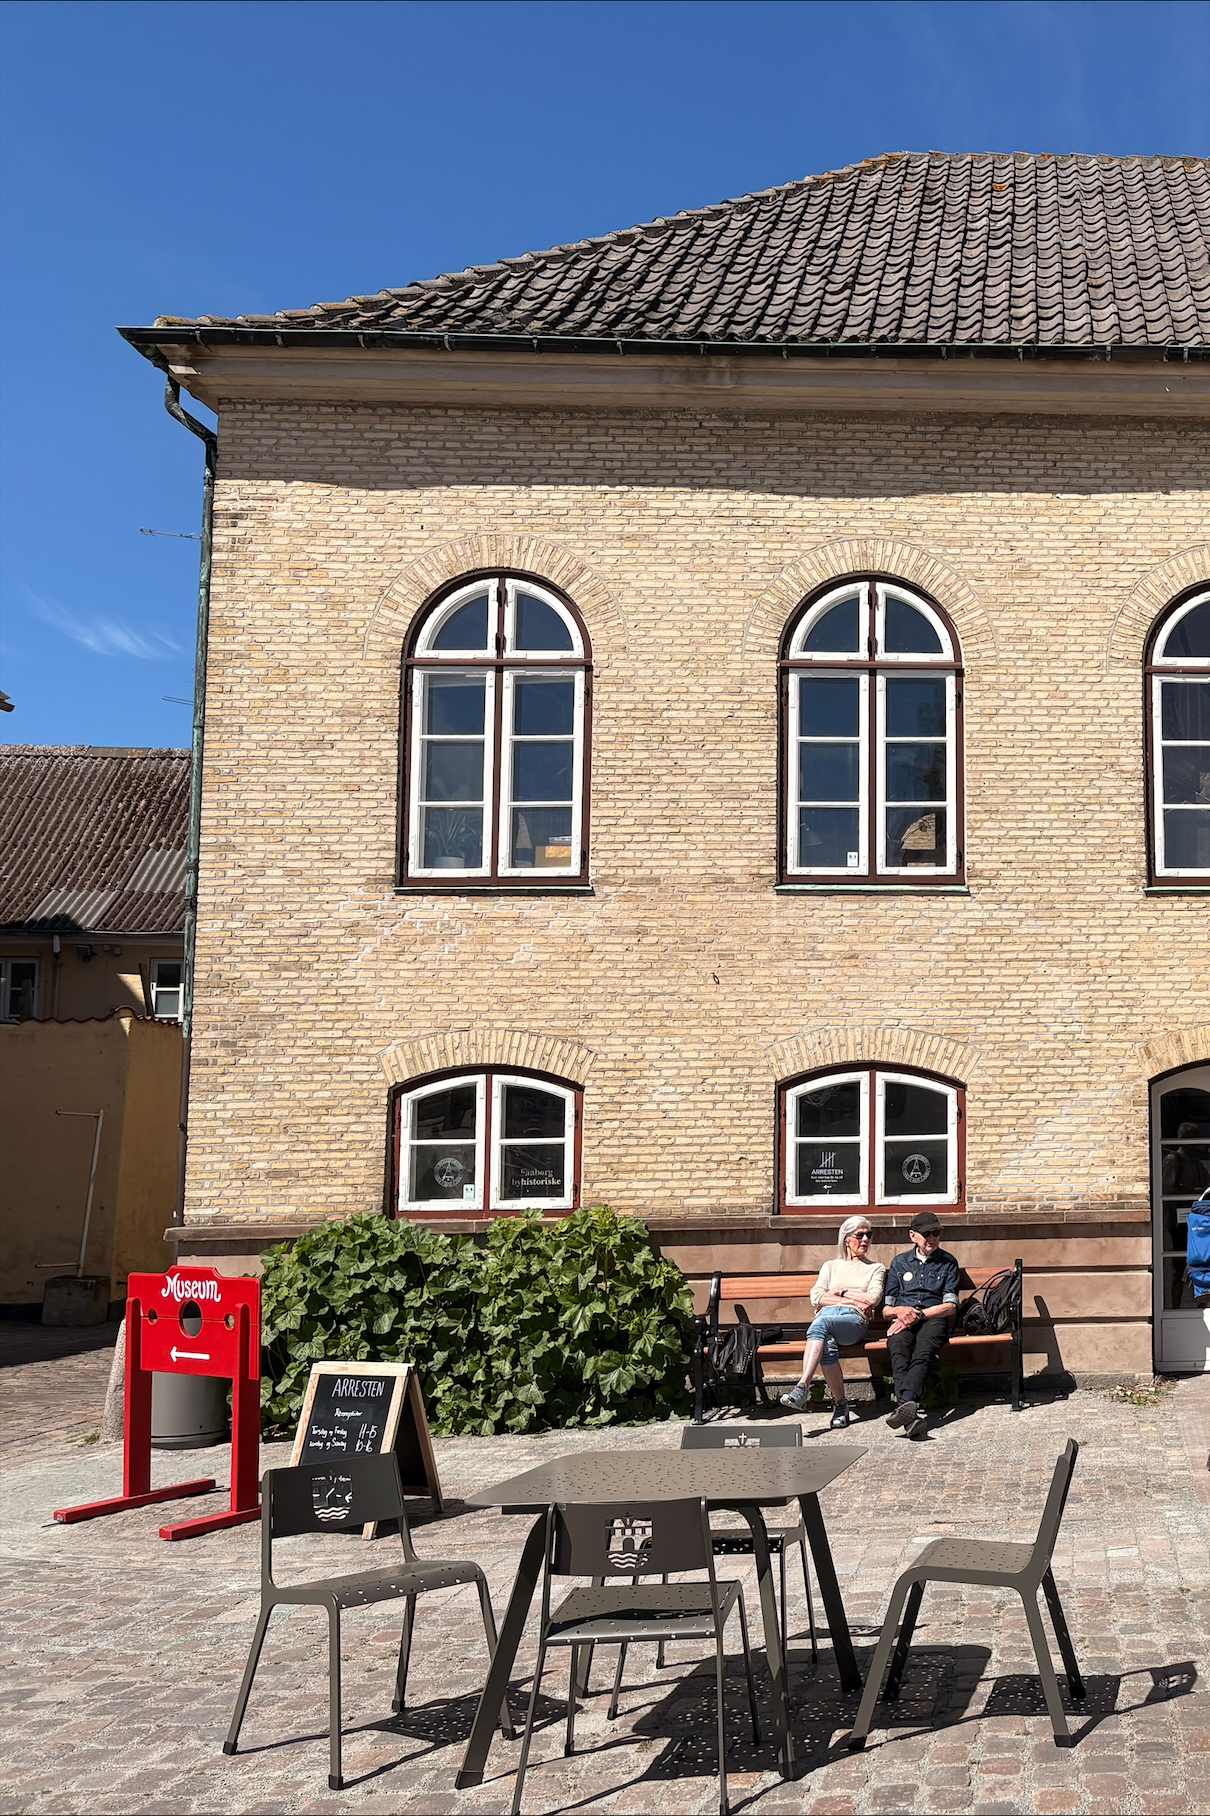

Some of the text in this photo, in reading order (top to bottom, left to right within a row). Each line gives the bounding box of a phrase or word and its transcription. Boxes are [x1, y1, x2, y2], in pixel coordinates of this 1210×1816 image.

[511, 1177, 561, 1187] byhistoriske
[161, 1272, 222, 1303] Museum
[331, 1378, 385, 1397] ARRESTEN
